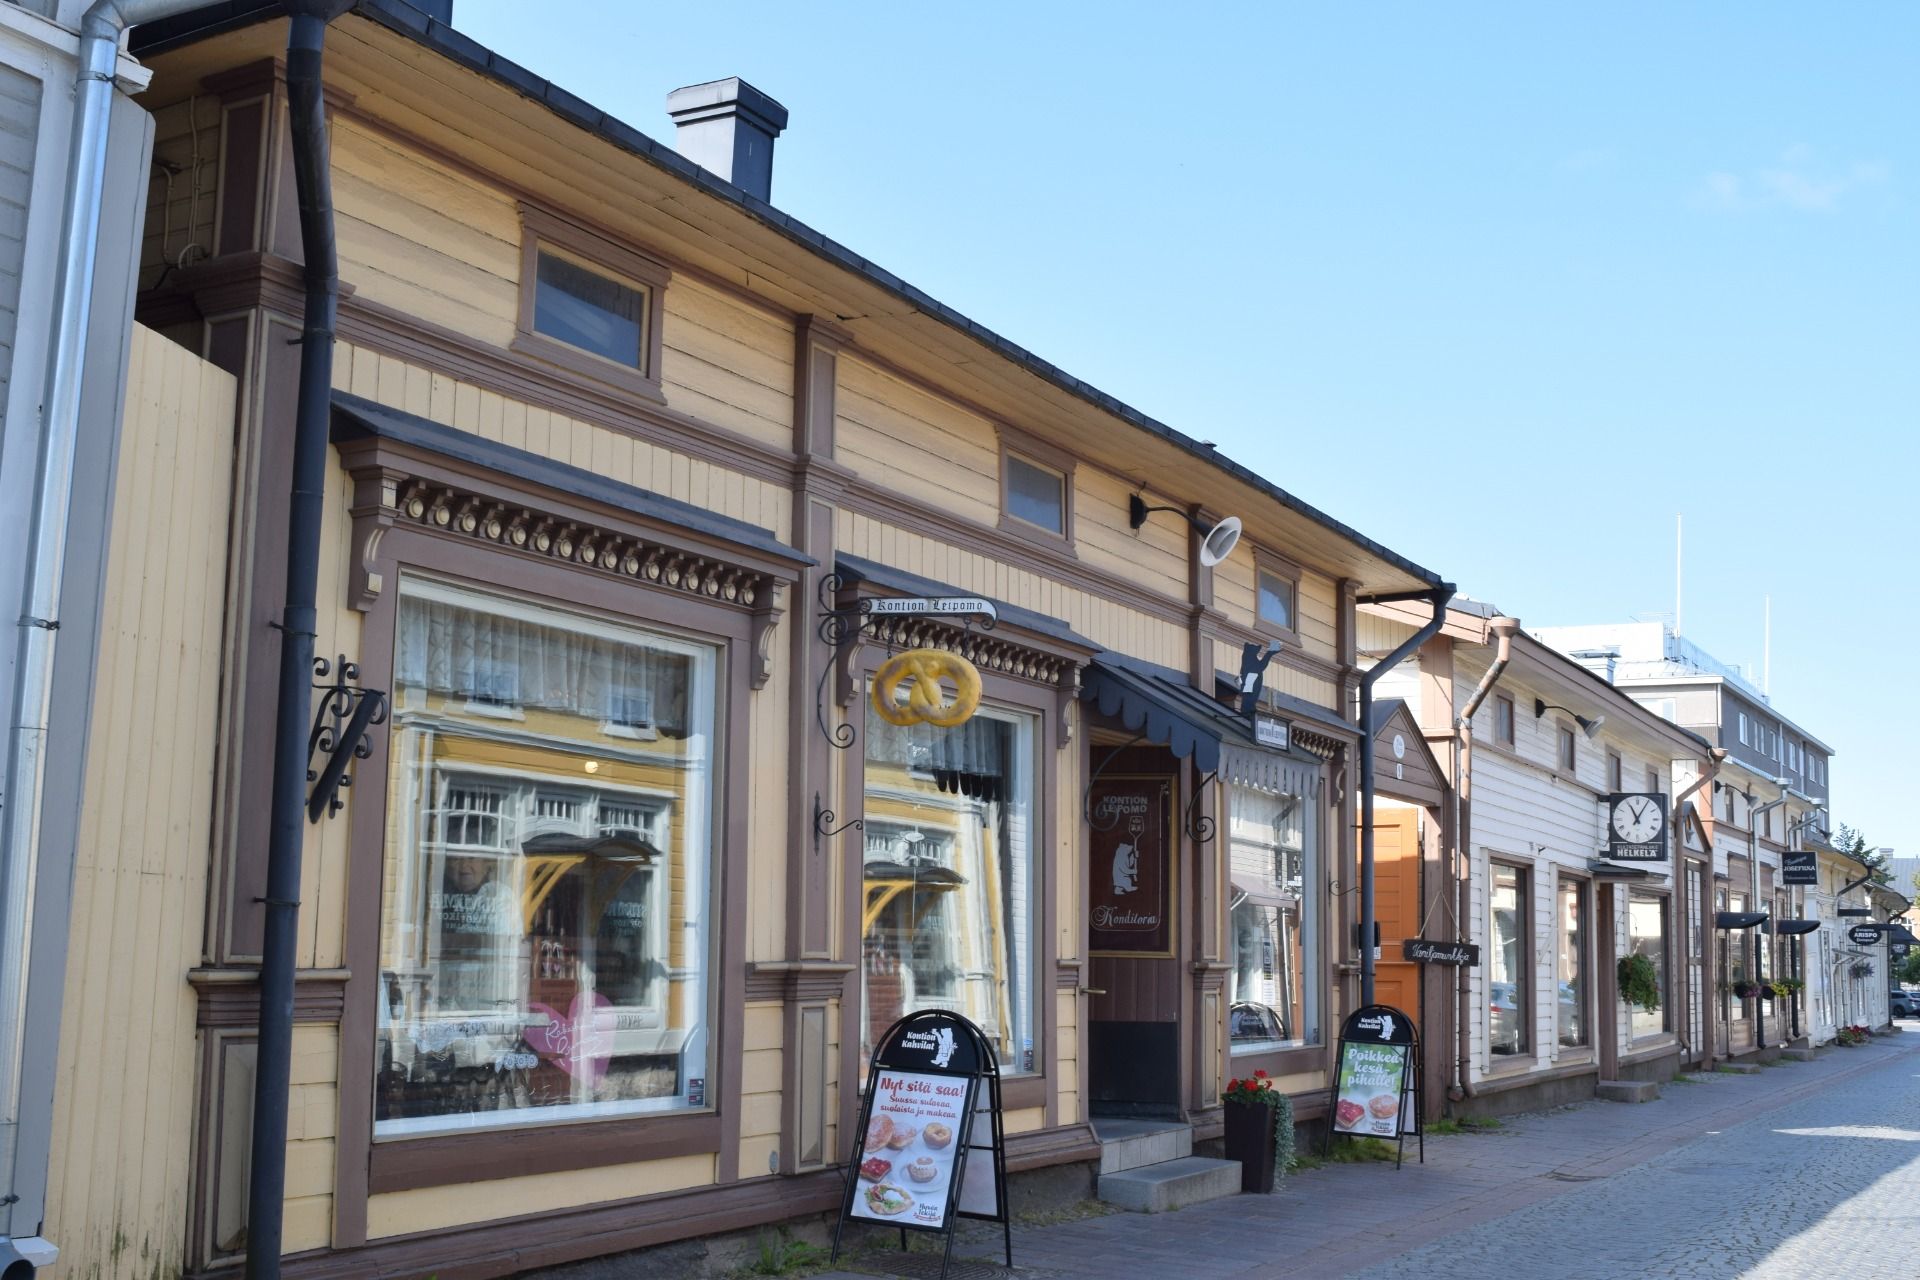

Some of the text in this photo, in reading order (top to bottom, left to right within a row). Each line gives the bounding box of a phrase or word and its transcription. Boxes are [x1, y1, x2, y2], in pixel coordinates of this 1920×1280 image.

[877, 600, 982, 611] Kontion Leipomo
[1104, 796, 1148, 804] KONTION
[1096, 906, 1157, 926] Konditoria
[907, 1031, 936, 1041] Kontion
[902, 1040, 935, 1050] Kahvilat
[1348, 1048, 1400, 1064] Poikkea
[1353, 1060, 1390, 1074] kesä-
[880, 1077, 964, 1098] Nyt sitä saa!
[1347, 1074, 1395, 1088] pihalle!
[889, 1095, 918, 1105] Suussa
[880, 1104, 915, 1114] suolaista
[915, 1107, 924, 1117] ja
